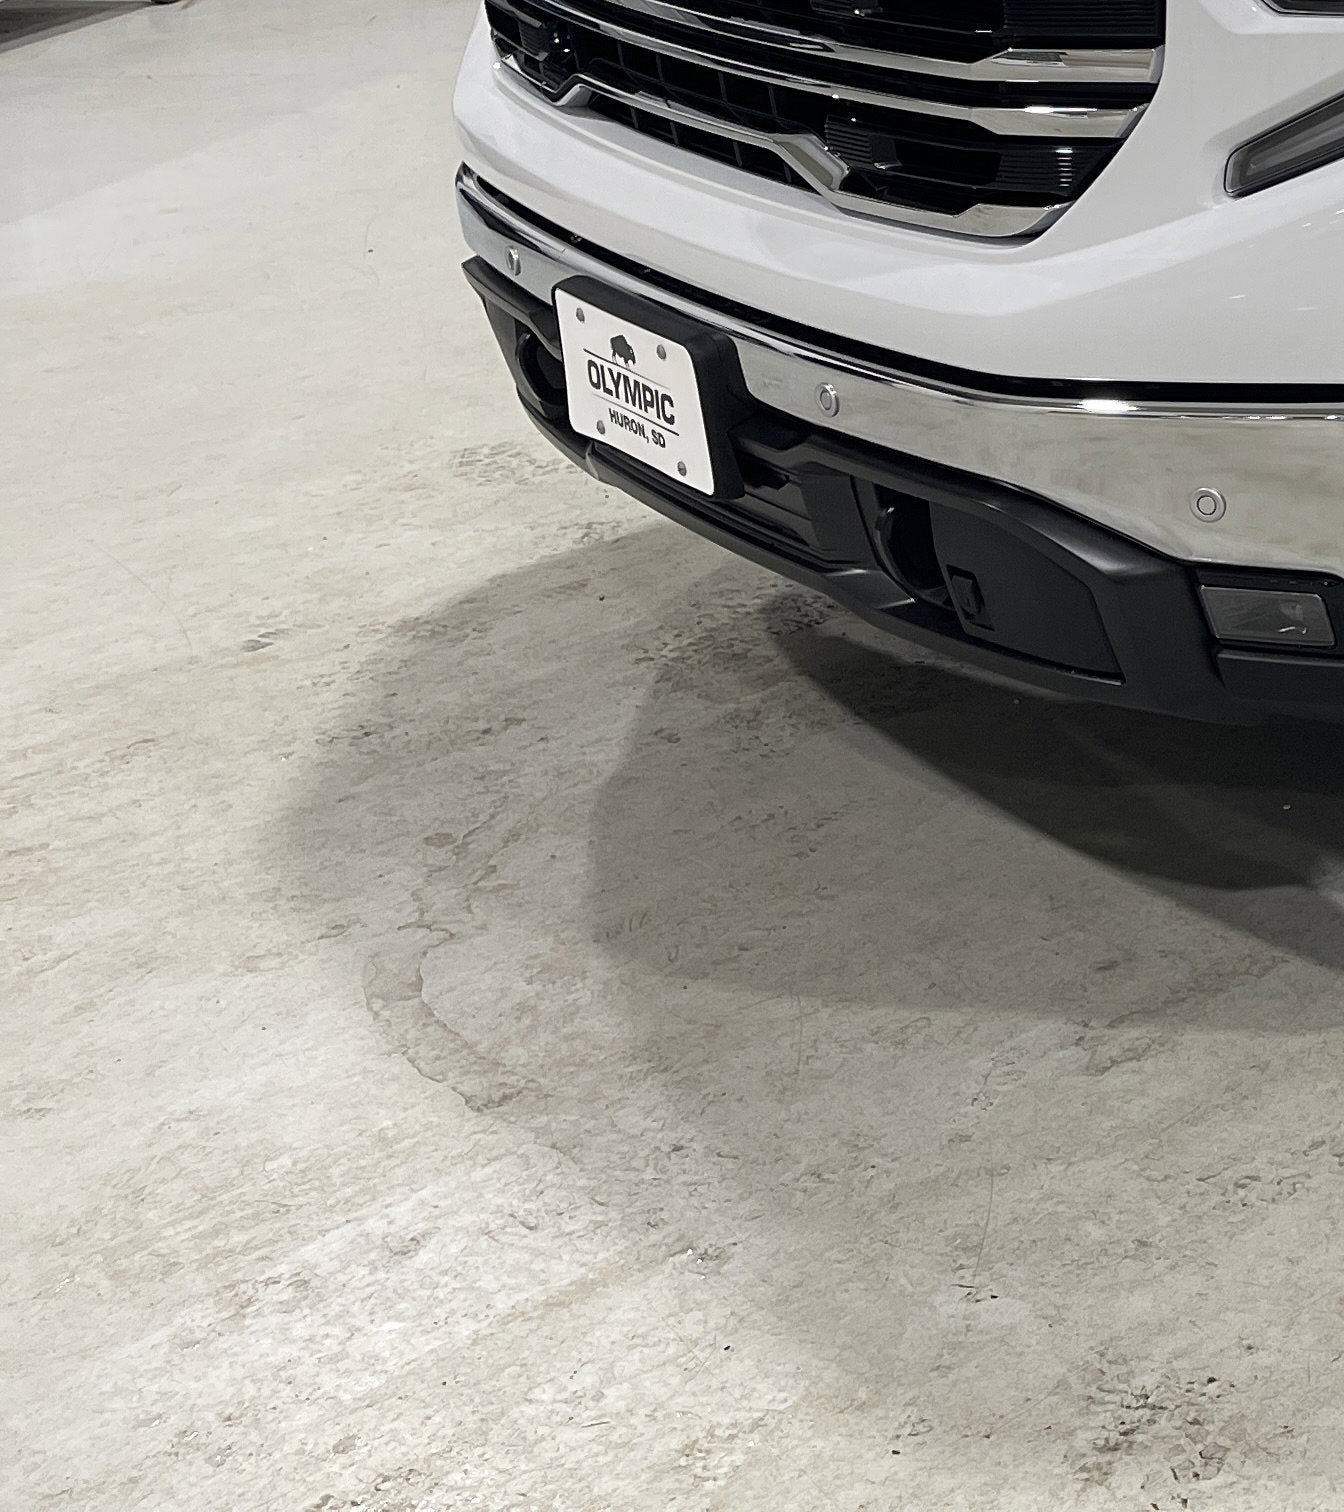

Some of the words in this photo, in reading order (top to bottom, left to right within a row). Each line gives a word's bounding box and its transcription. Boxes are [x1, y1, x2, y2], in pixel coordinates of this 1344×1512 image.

[587, 359, 676, 426] OLYMPIC
[608, 407, 650, 444] HURON,
[651, 431, 666, 448] SD
